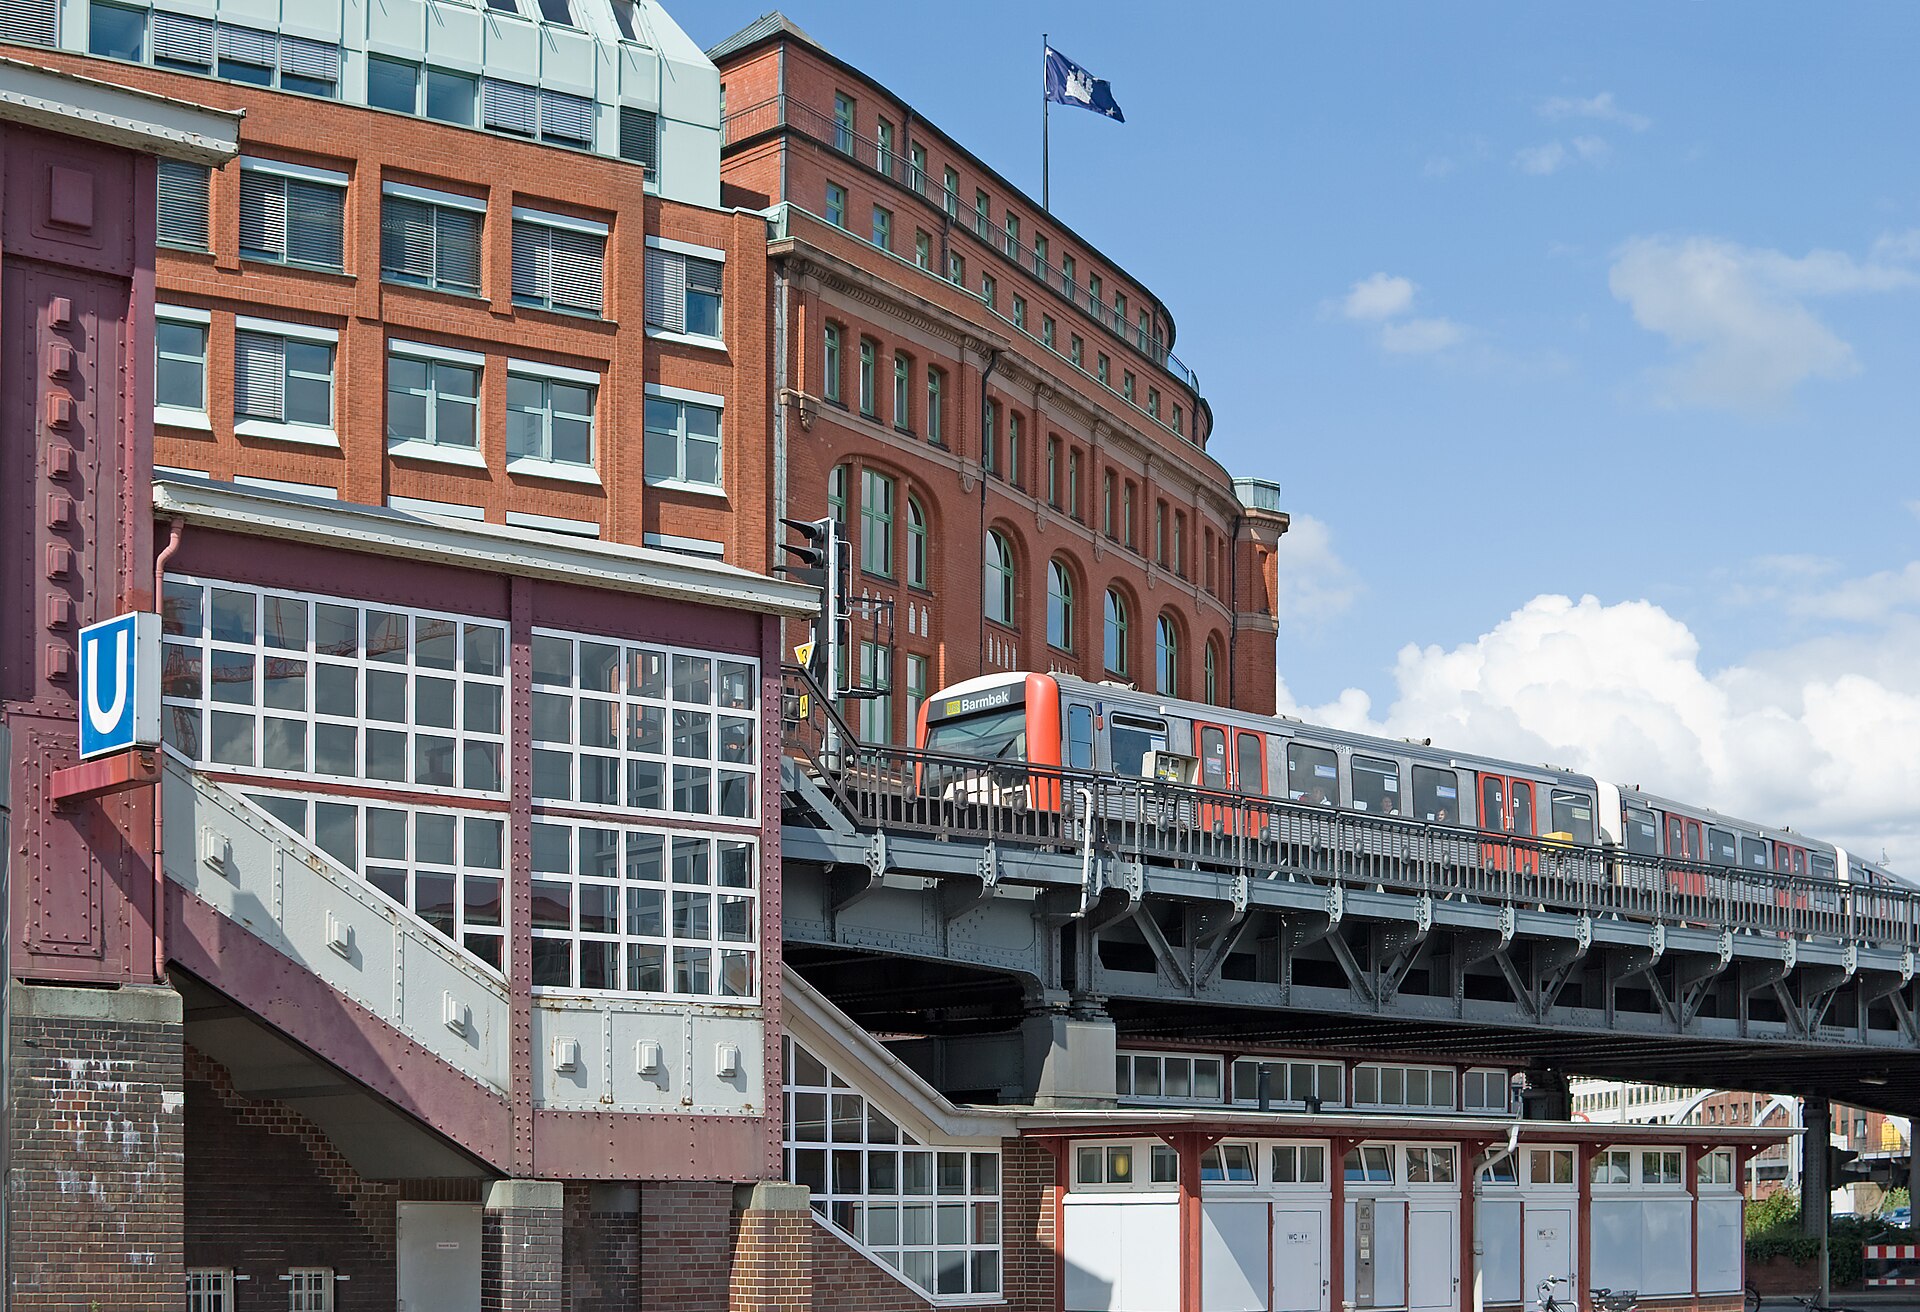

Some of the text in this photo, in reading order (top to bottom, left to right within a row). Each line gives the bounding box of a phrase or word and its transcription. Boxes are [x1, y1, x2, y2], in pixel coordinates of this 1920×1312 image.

[801, 648, 808, 665] 3
[87, 629, 128, 734] U
[961, 691, 1009, 712] Barmbek
